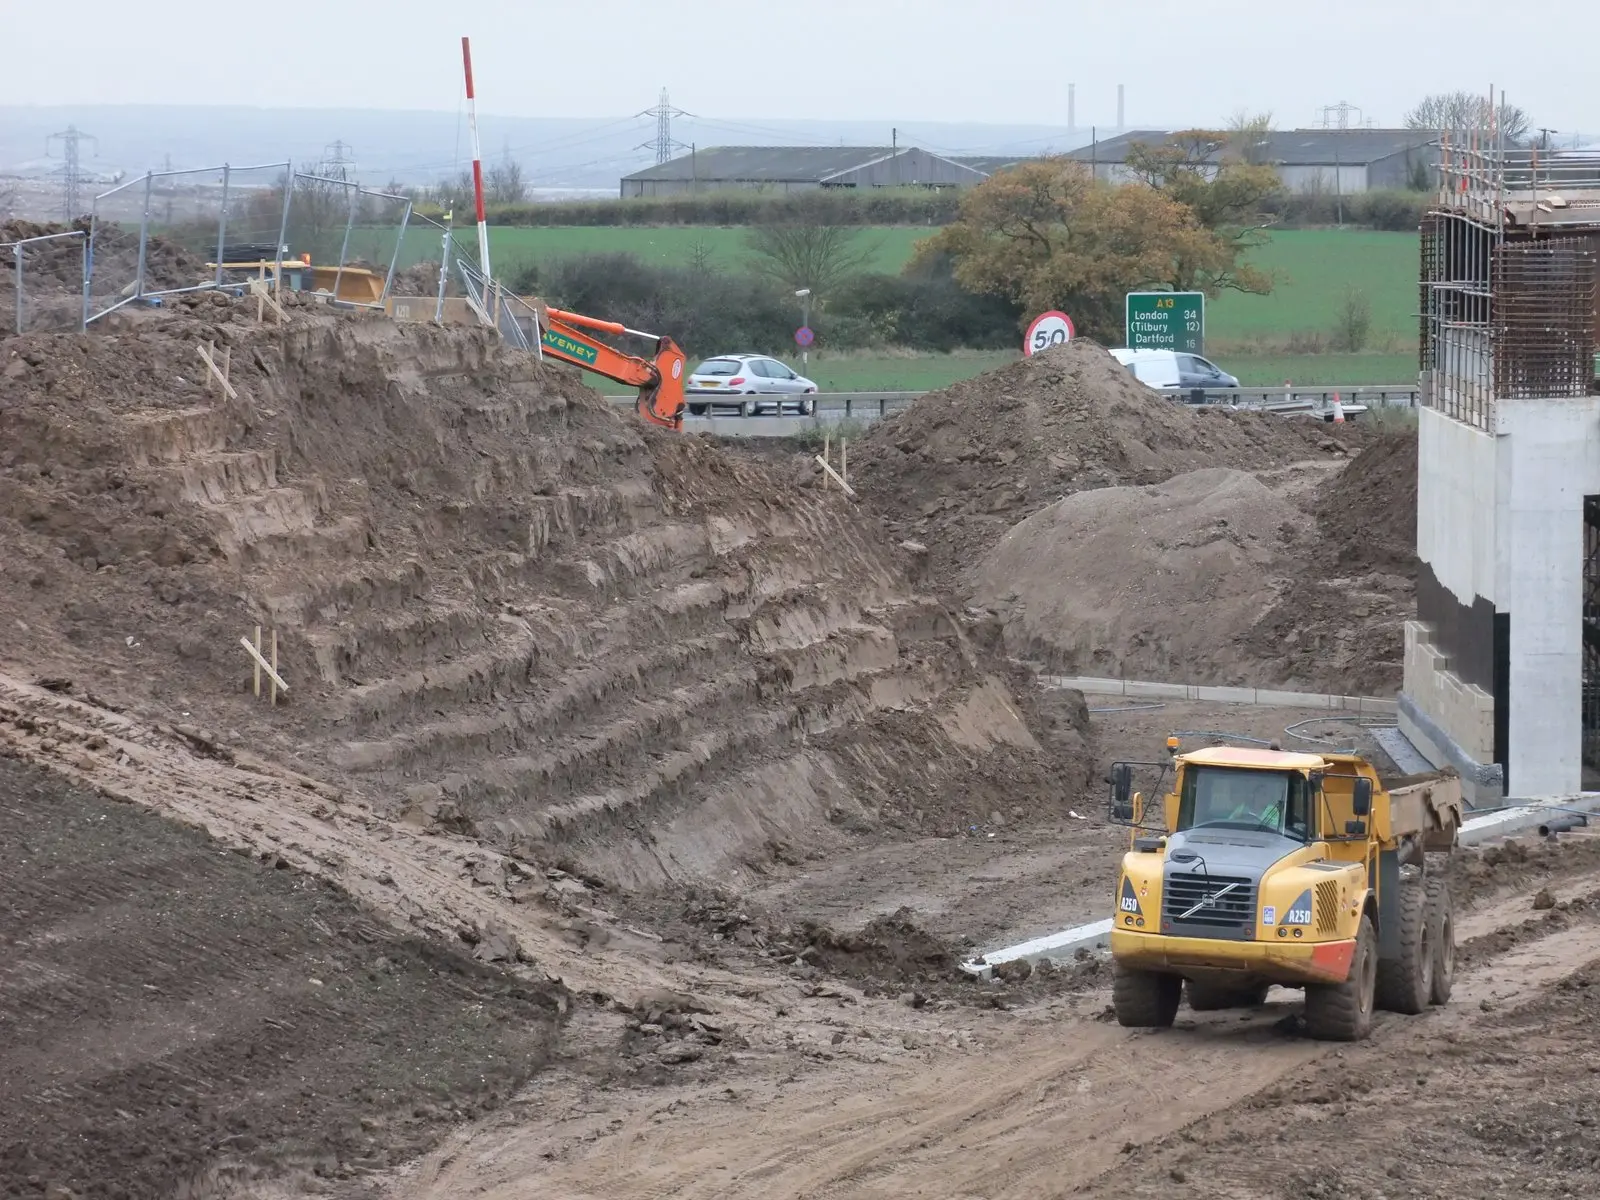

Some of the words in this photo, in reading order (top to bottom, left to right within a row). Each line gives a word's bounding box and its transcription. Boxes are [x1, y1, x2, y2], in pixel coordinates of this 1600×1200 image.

[1157, 298, 1174, 309] A13
[1134, 310, 1169, 320] London
[1183, 309, 1197, 320] 34
[1130, 321, 1168, 333] (Tilbury
[1186, 321, 1200, 332] 12)
[1034, 328, 1066, 349] 50
[1135, 333, 1175, 343] Dartford
[1186, 339, 1196, 349] 16
[1288, 909, 1311, 924] A25D
